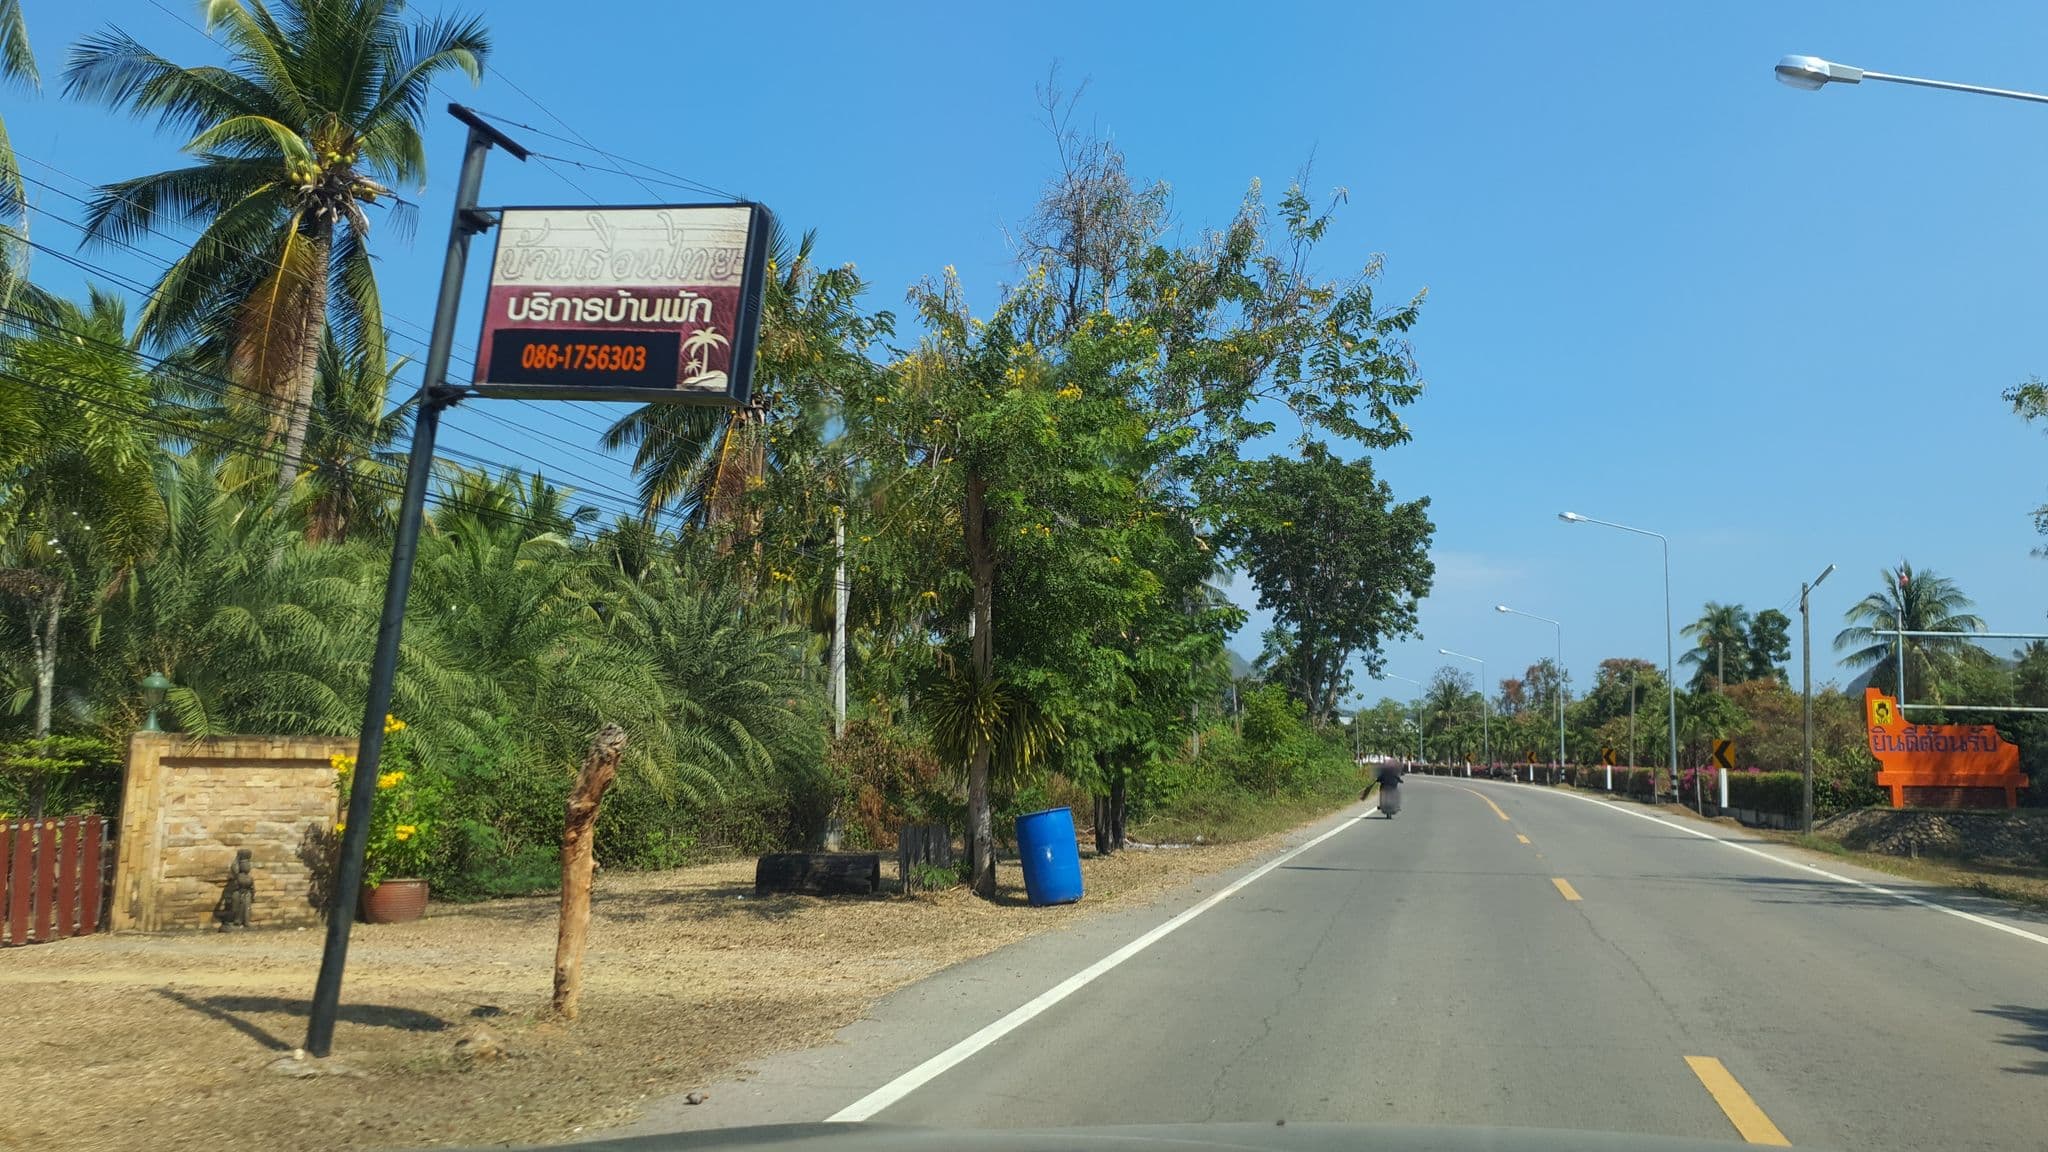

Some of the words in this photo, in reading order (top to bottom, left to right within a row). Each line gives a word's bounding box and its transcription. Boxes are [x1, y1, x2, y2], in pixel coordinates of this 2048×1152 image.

[507, 289, 713, 324] บริการบ้านพัก
[521, 343, 648, 373] 086-1756303
[1871, 725, 1998, 753] ยินดีต้อนรับ
